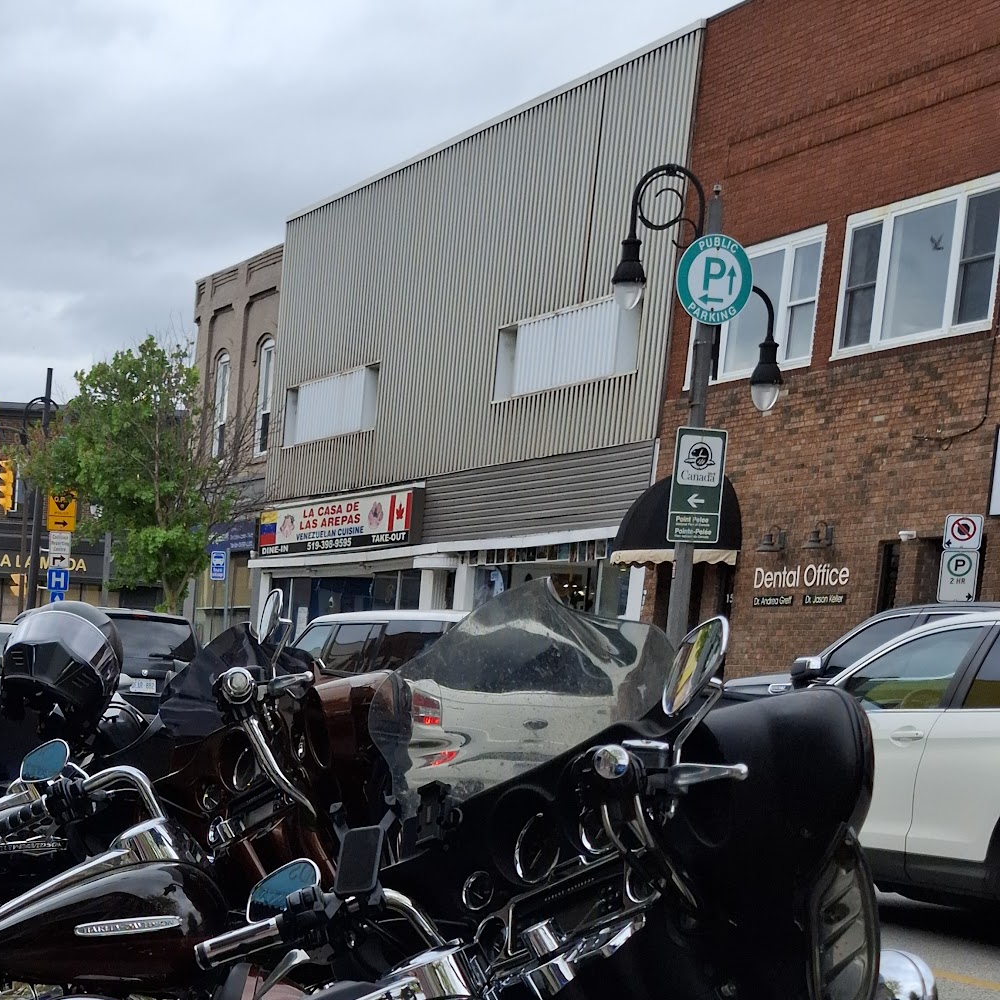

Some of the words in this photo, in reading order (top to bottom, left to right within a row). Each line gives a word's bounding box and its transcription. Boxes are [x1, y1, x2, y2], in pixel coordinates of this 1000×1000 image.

[698, 237, 738, 253] PUBLIC
[703, 257, 726, 291] P
[688, 302, 736, 322] PARKING
[681, 470, 715, 483] Canada
[303, 509, 314, 519] LA
[317, 505, 343, 517] CASA
[345, 502, 360, 513] DE
[299, 519, 318, 531] LAS
[320, 513, 361, 527] AREPAS
[296, 529, 336, 541] VENEZUELAN
[337, 525, 364, 536] CUISINE
[371, 532, 406, 543] TAKE-OUT
[261, 544, 289, 555] DINE-IN
[306, 538, 352, 551] 519-398-9595
[954, 559, 966, 571] P
[51, 571, 65, 588] H
[753, 565, 801, 588] Dental
[803, 563, 850, 587] Office
[812, 595, 828, 604] Jason
